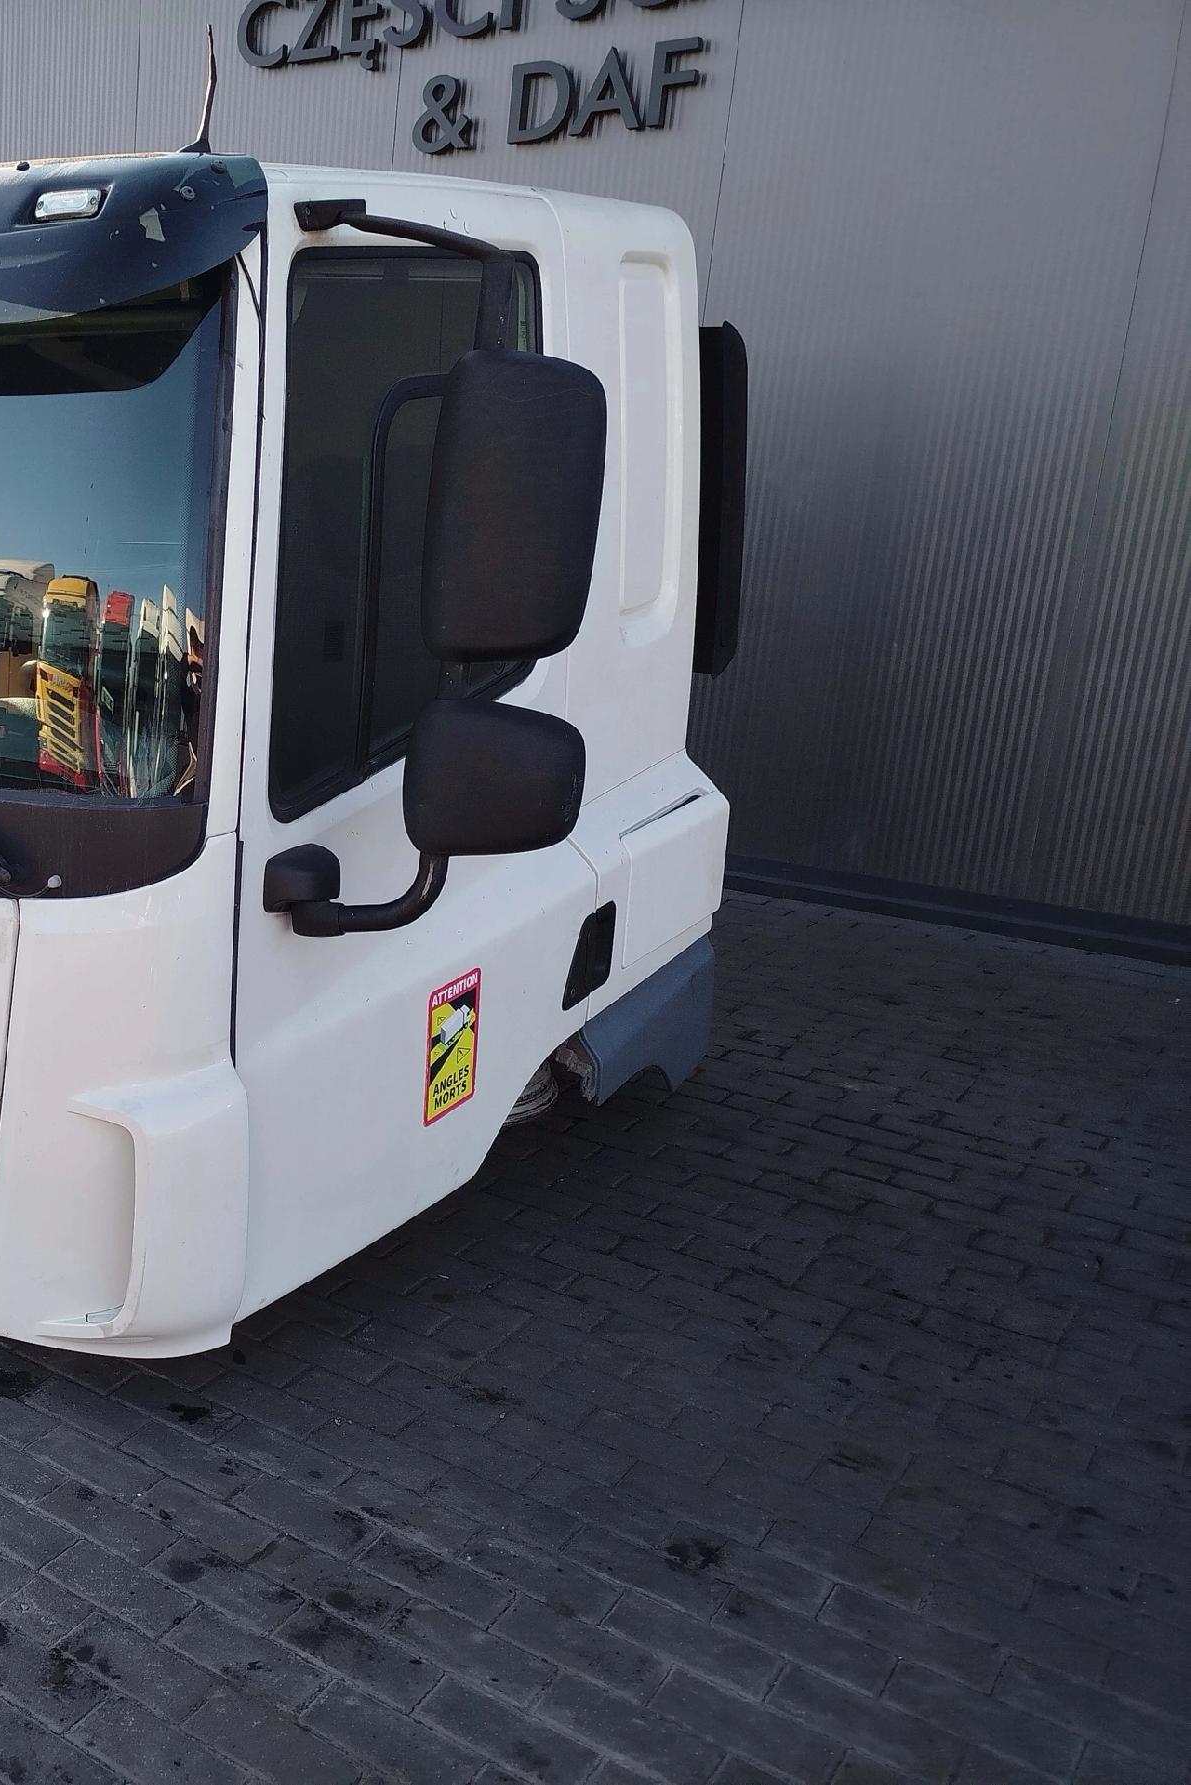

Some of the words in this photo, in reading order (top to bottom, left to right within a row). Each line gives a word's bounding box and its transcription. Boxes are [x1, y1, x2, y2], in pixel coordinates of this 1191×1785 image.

[412, 74, 471, 154] &
[507, 37, 704, 145] DAF
[431, 972, 478, 1008] ATTENTION
[432, 1064, 470, 1098] ANGLES
[434, 1080, 467, 1111] MORTS
